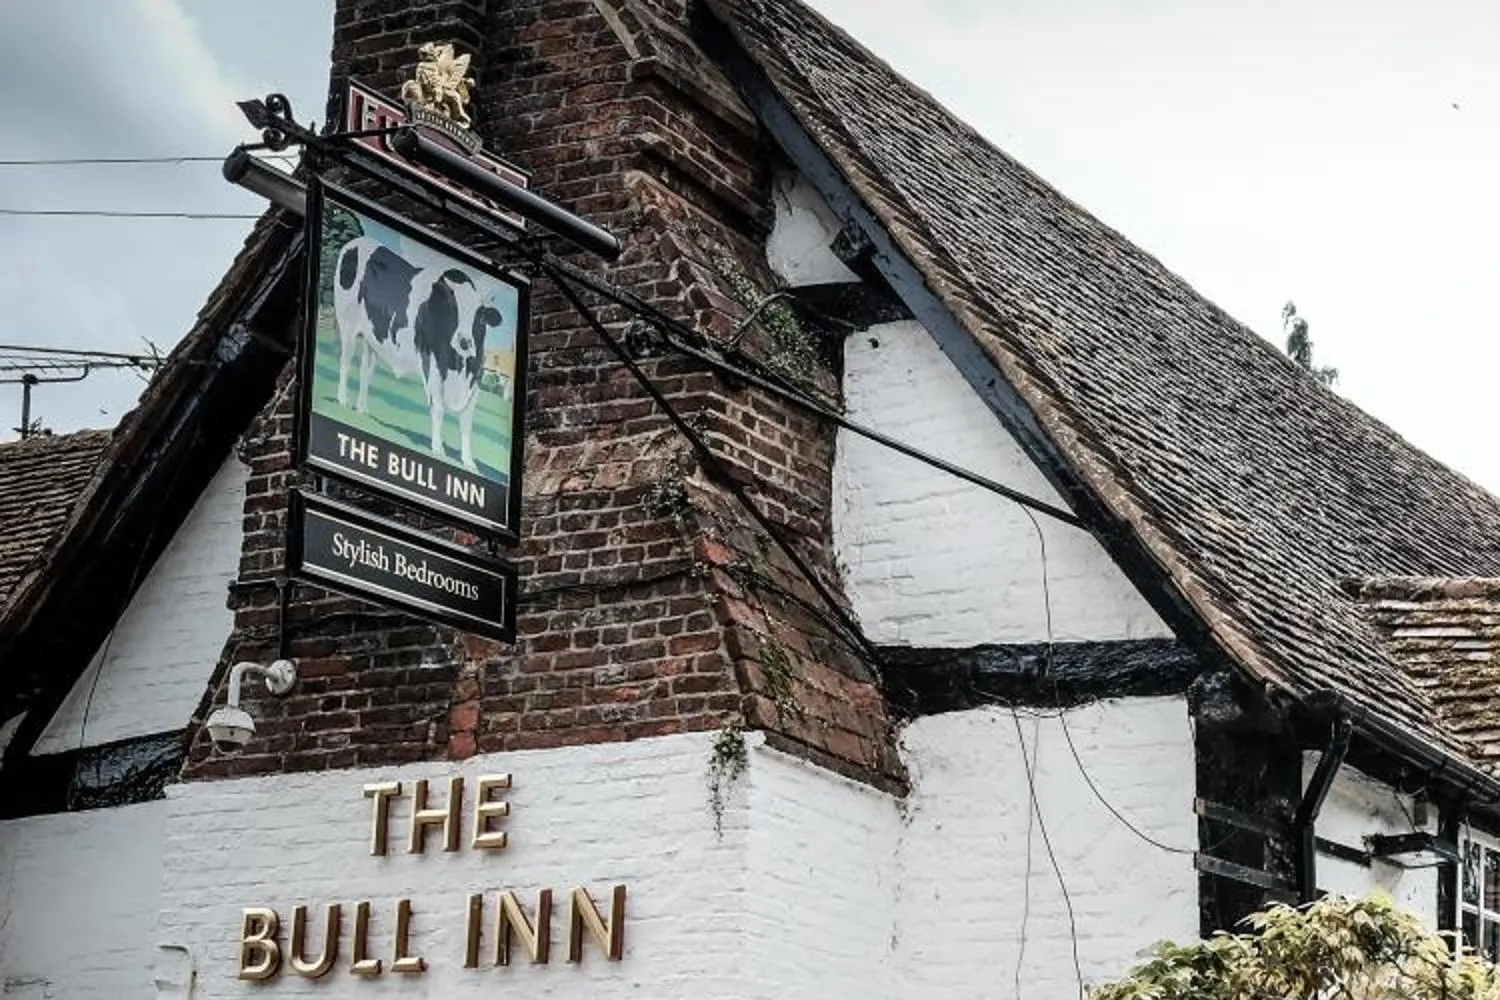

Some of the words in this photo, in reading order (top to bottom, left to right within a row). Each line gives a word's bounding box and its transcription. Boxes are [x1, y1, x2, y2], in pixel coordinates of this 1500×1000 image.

[337, 432, 379, 469] THE
[388, 452, 438, 490] BULL
[446, 473, 486, 509] INN
[332, 532, 390, 573] Stylish
[394, 552, 479, 600] Bedrooms
[364, 772, 513, 857] THE
[239, 898, 427, 980] BULL
[464, 883, 628, 969] INN
